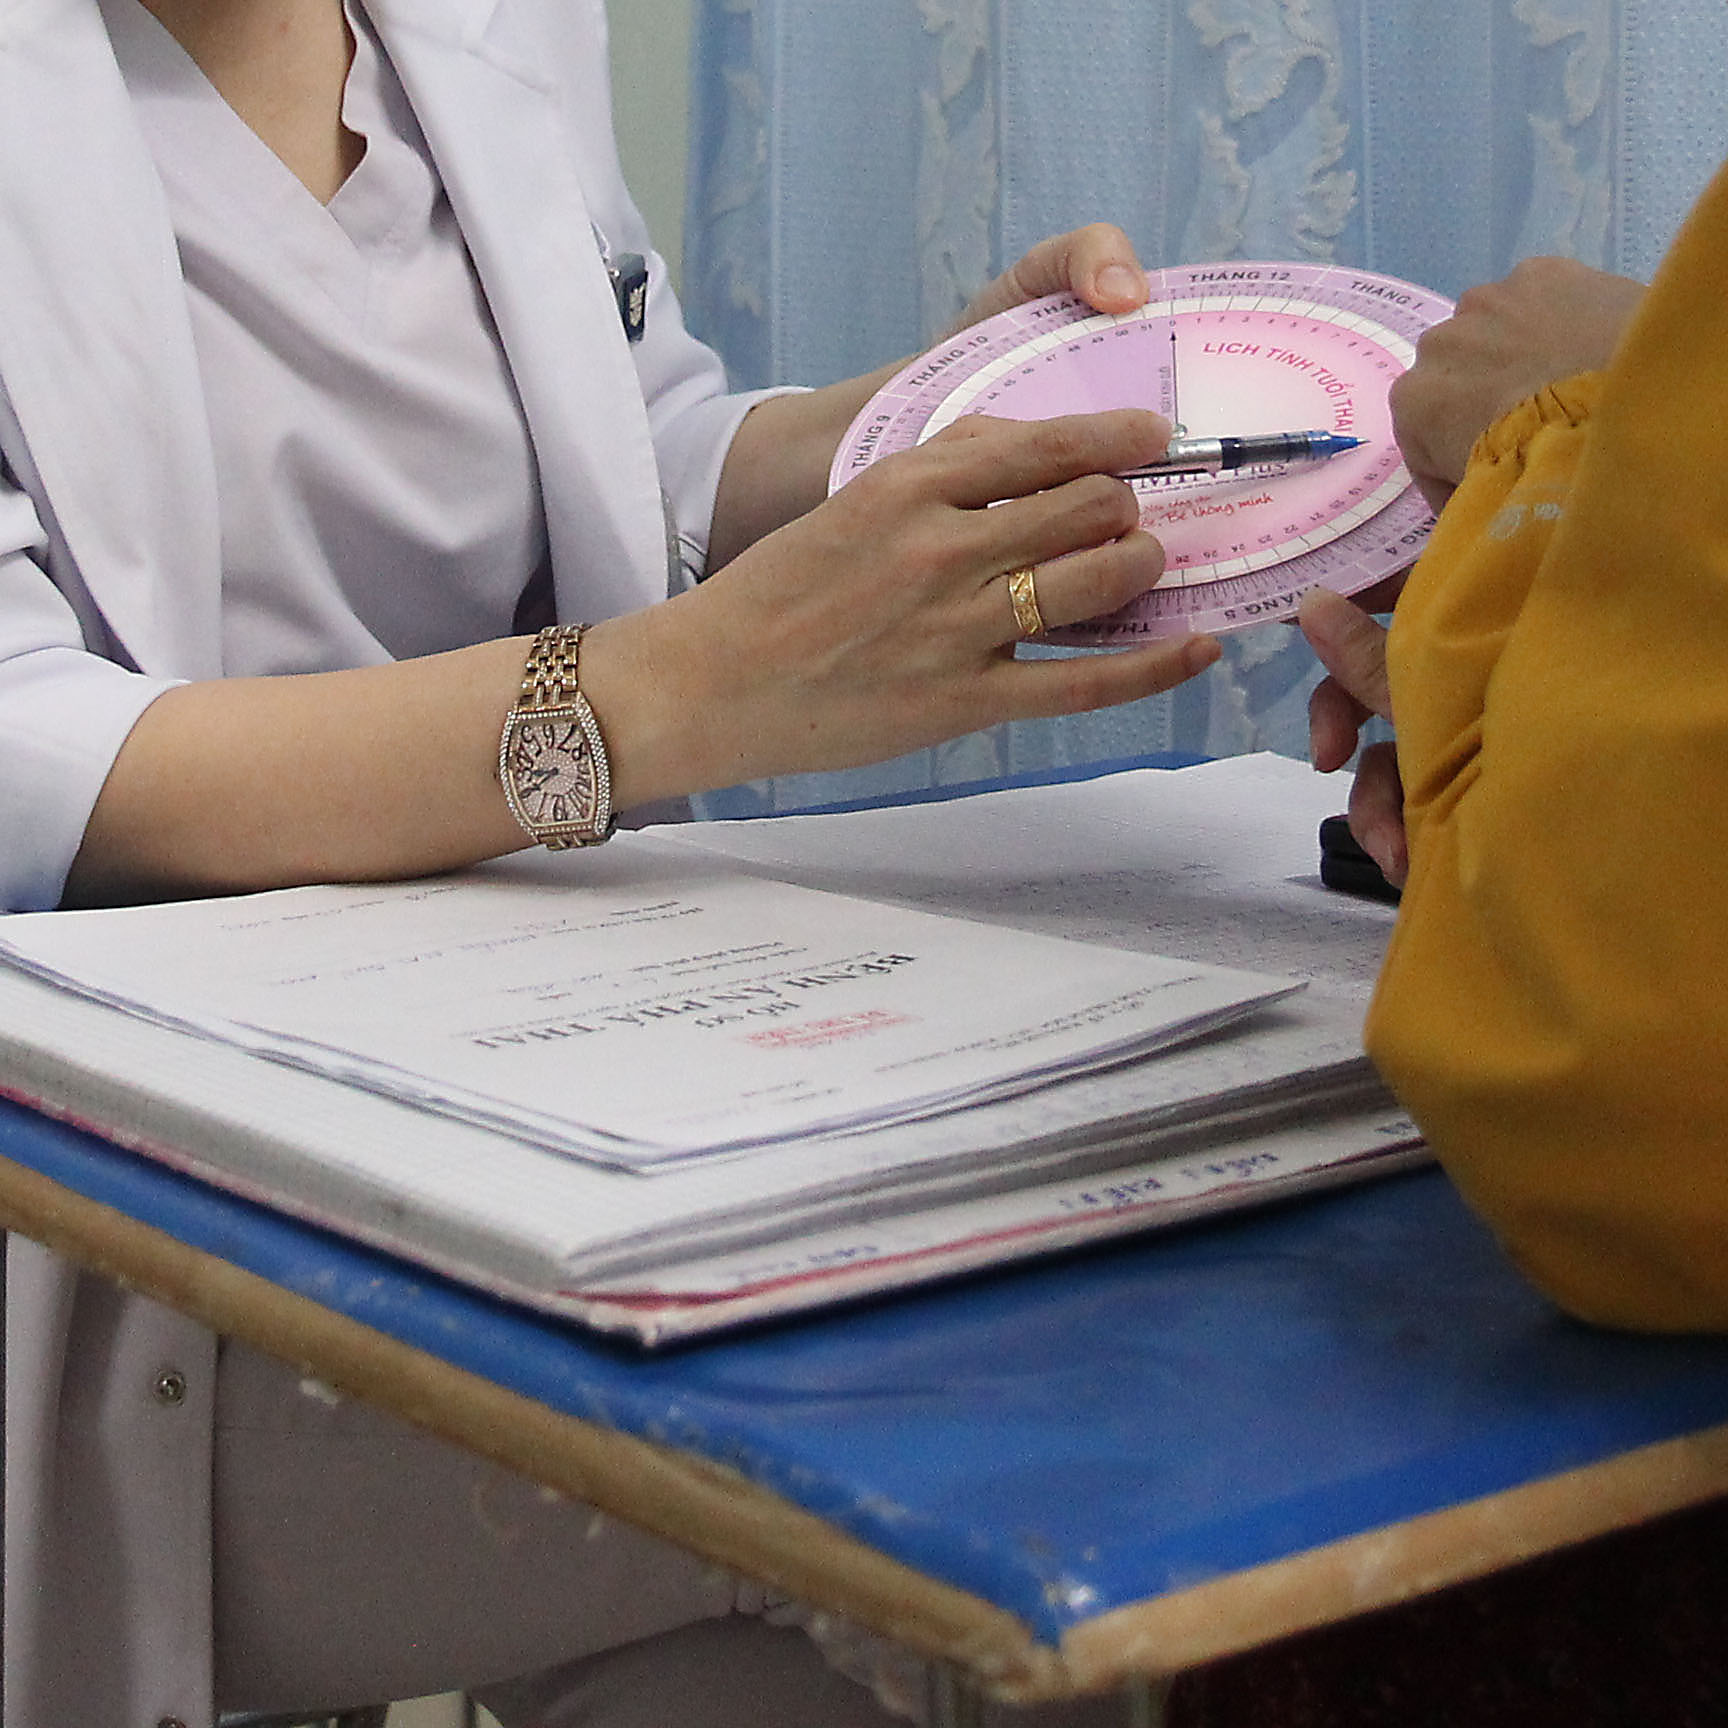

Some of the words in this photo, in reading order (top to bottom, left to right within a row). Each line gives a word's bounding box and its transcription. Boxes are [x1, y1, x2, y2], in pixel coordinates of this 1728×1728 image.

[1270, 271, 1291, 281] 12
[1411, 302, 1424, 311] 1
[967, 335, 989, 348] 10
[1202, 342, 1261, 358] LỊCH
[1332, 398, 1354, 433] THAI
[876, 414, 891, 423] 9
[1238, 492, 1274, 509] minh
[1224, 610, 1237, 619] 5
[520, 725, 542, 757] 5
[543, 723, 555, 749] 6
[557, 724, 578, 753] 7
[782, 953, 919, 989] BỆNH
[602, 999, 712, 1027] PHÁ
